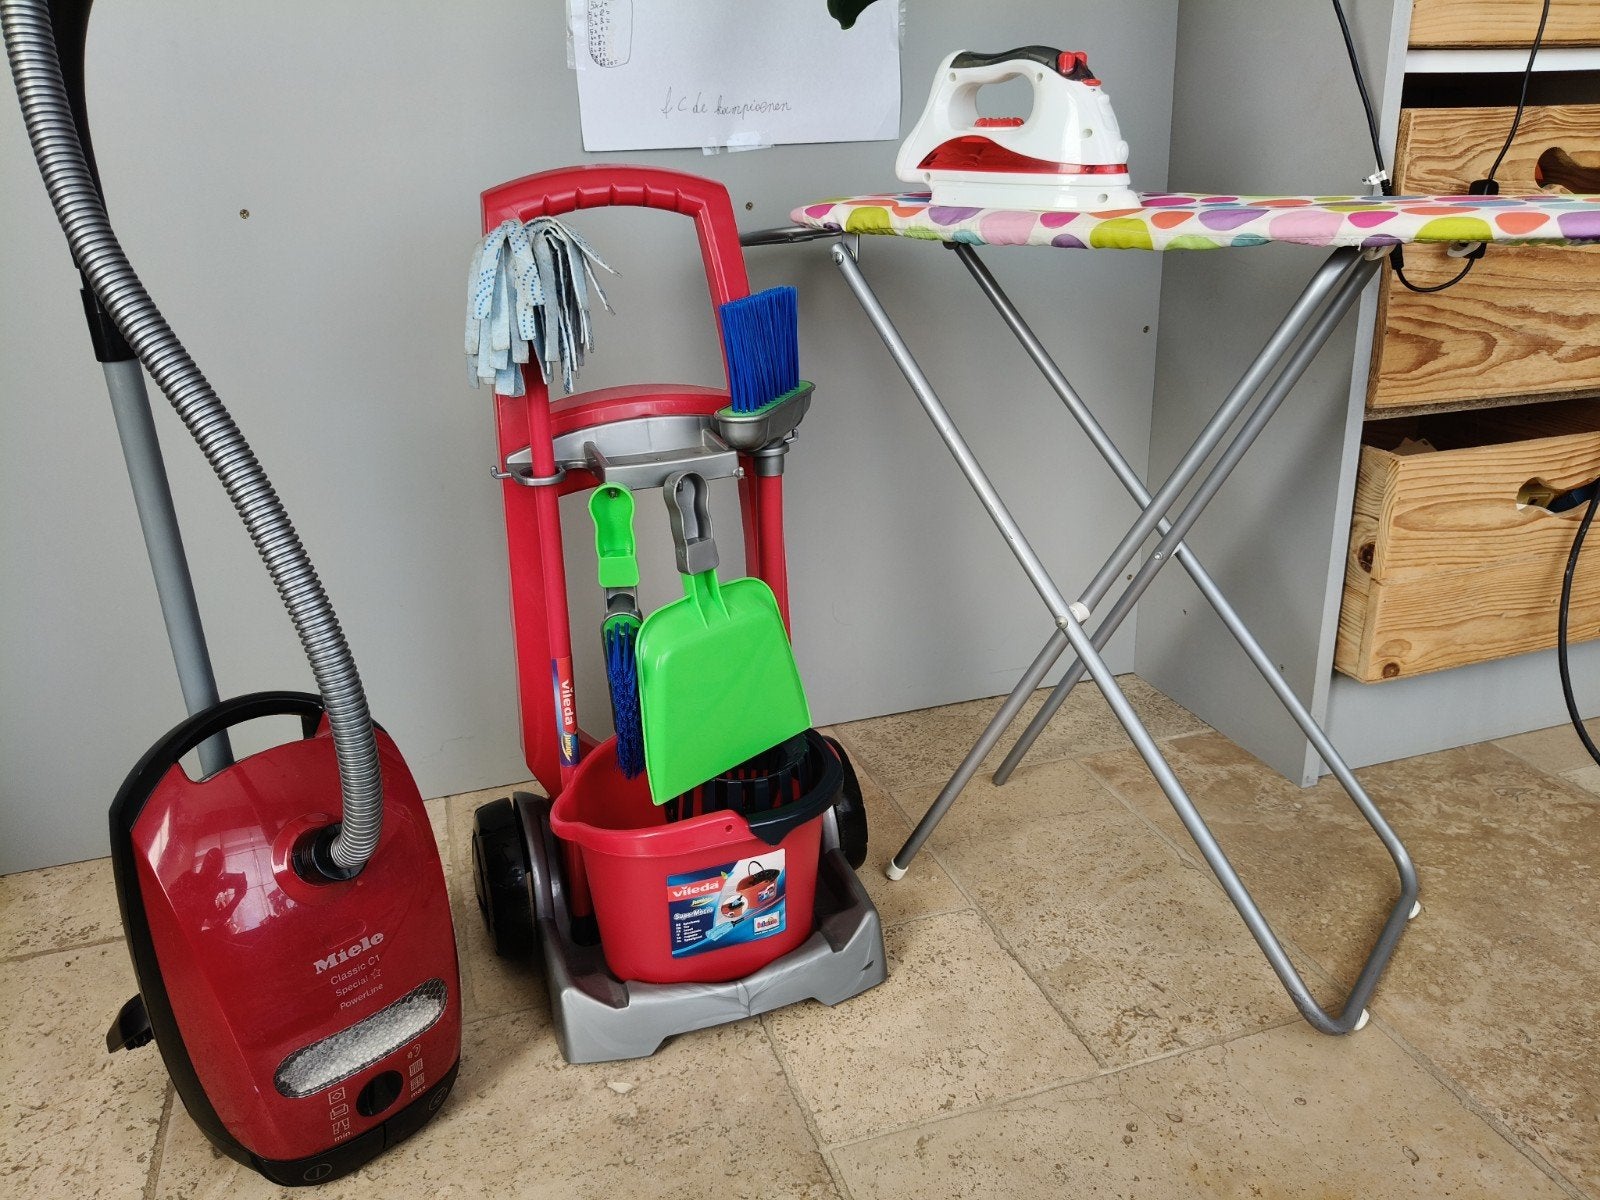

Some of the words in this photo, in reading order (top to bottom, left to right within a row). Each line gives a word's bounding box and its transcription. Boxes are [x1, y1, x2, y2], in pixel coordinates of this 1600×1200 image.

[561, 679, 574, 726] vileda
[672, 881, 719, 897] vileda
[313, 932, 384, 974] Miele
[330, 963, 366, 985] Classic
[367, 954, 381, 966] C1
[335, 975, 369, 996] Special
[340, 983, 384, 1010] PowerLine
